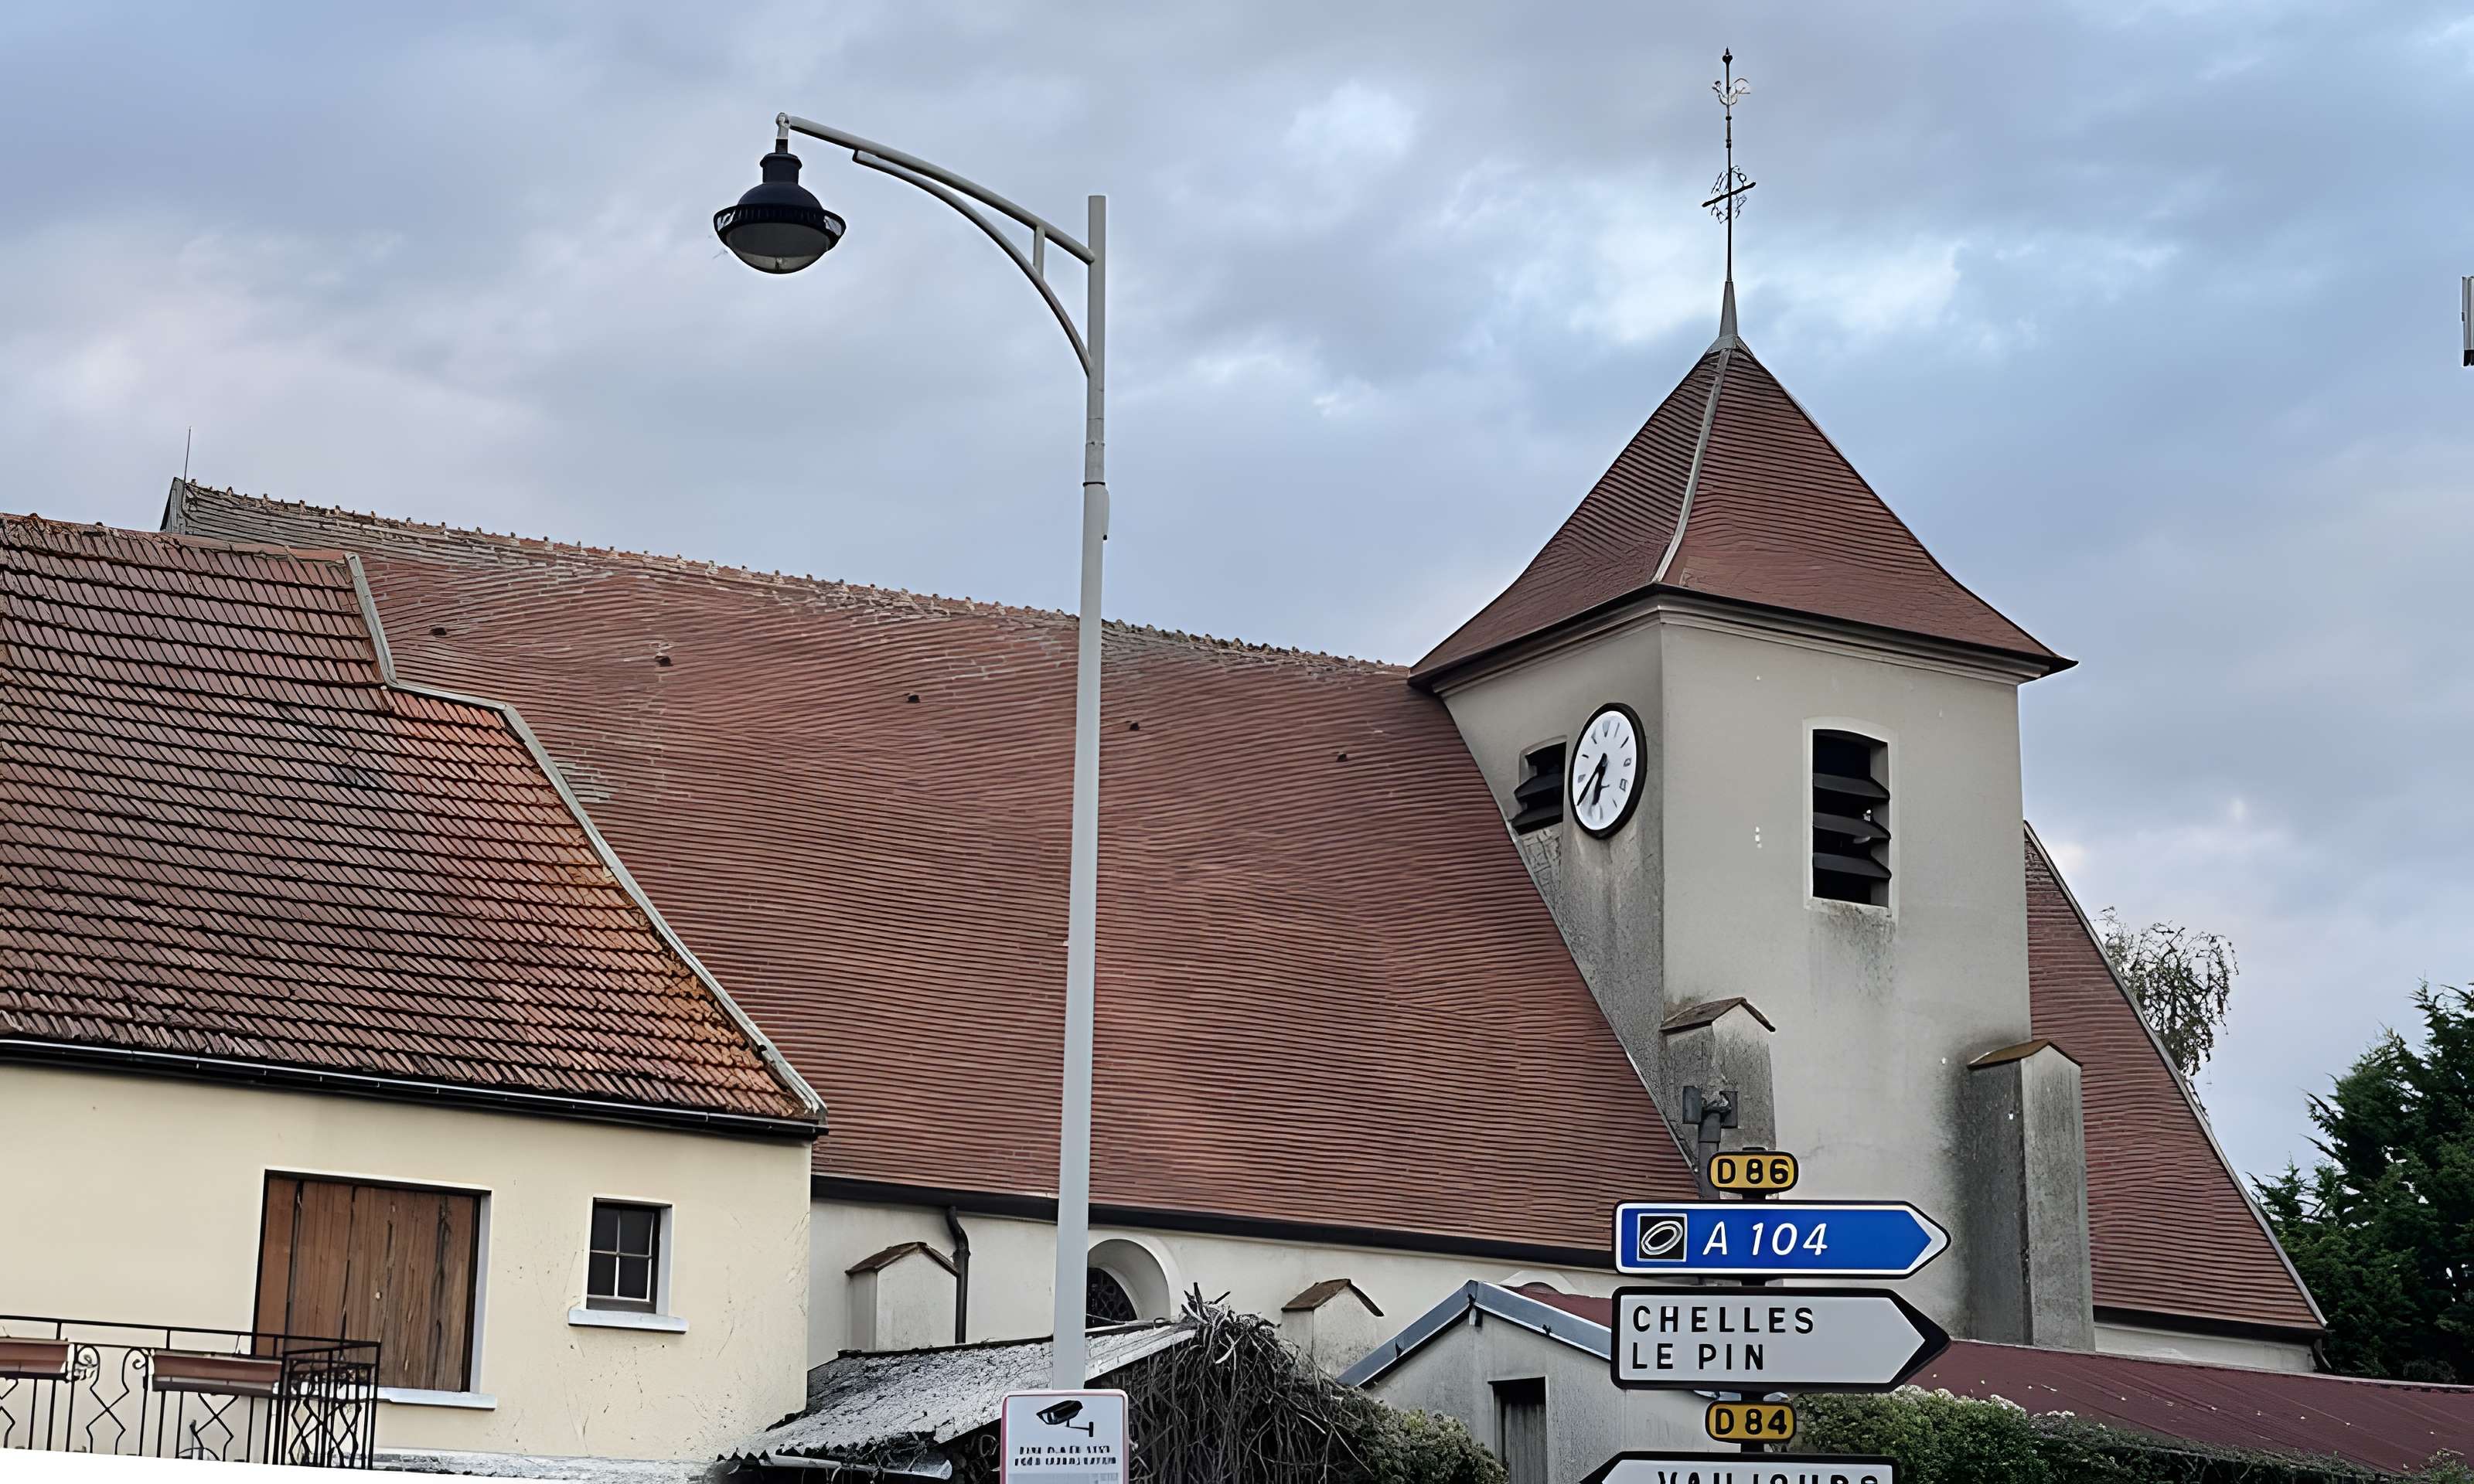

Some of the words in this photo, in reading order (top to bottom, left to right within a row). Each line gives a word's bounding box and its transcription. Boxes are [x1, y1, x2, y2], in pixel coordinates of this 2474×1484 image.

[1716, 1158, 1736, 1185] D
[1745, 1158, 1789, 1184] 86
[1702, 1220, 1728, 1255] A
[1752, 1222, 1828, 1256] 104
[1632, 1305, 1814, 1334] CHELLES
[1632, 1342, 1674, 1370] LE
[1699, 1343, 1764, 1370] PIN
[1714, 1407, 1735, 1435] D
[1744, 1407, 1787, 1435] 84
